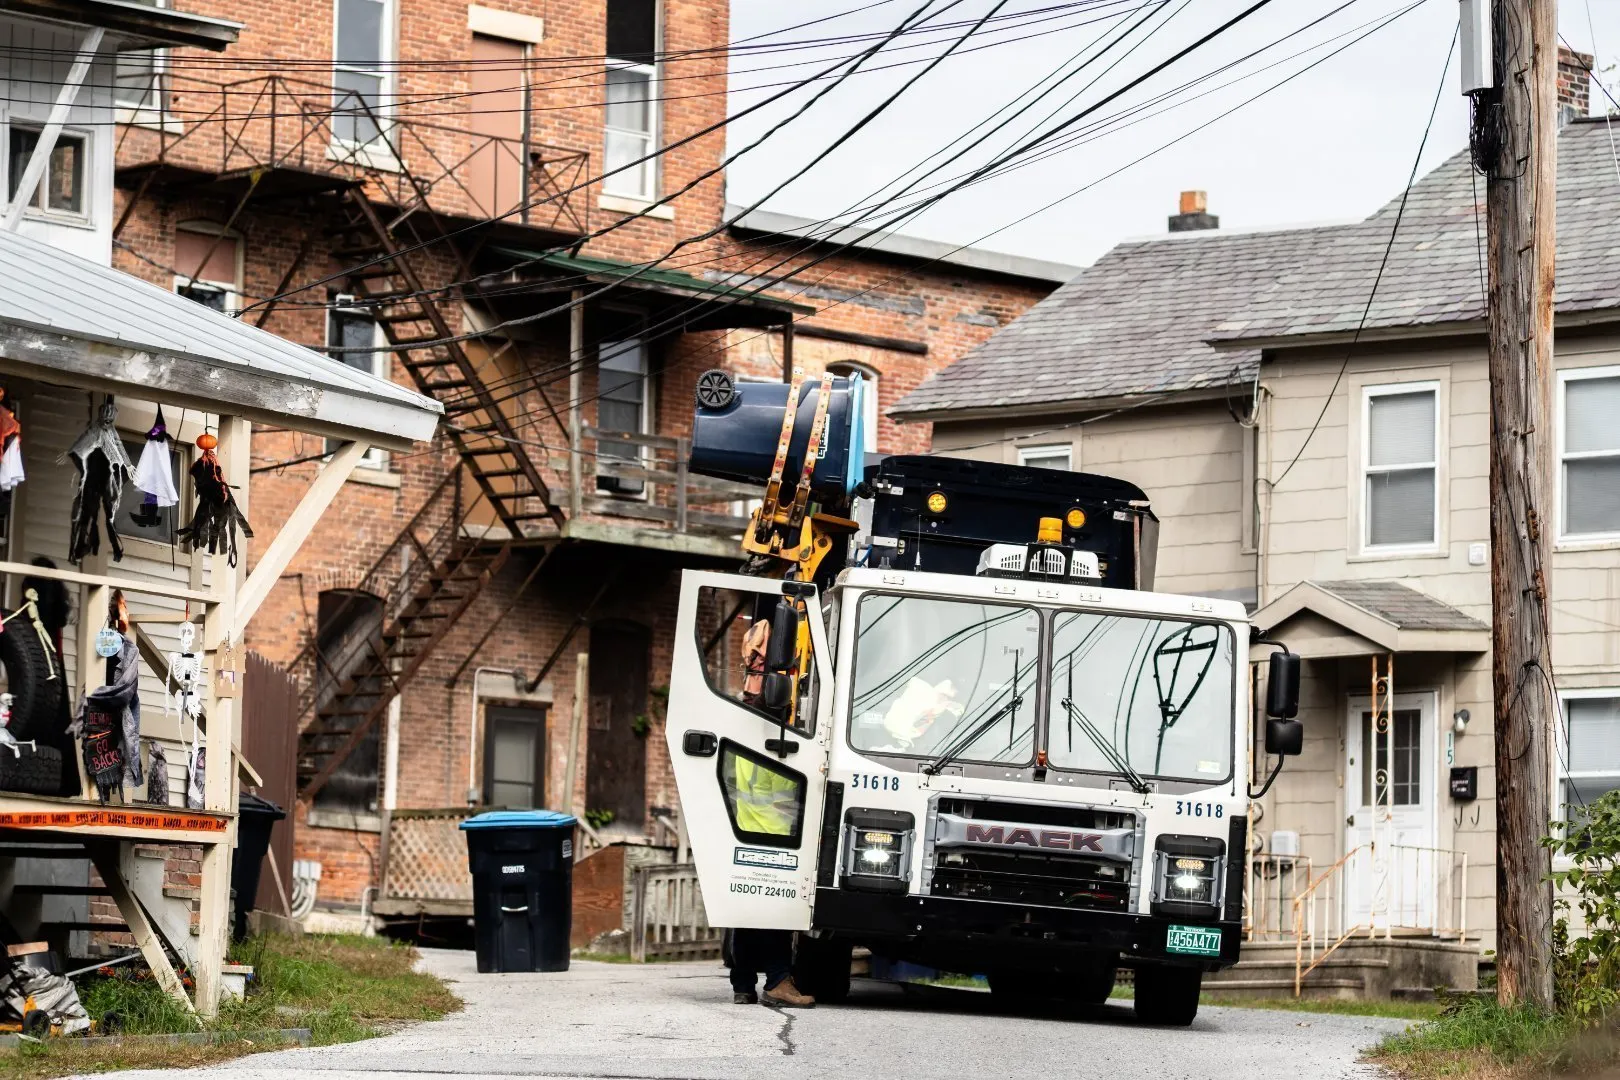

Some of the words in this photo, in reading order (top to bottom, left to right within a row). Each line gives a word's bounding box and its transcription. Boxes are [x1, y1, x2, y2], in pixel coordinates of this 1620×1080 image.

[96, 739, 108, 755] GO
[1447, 733, 1453, 765] 15
[92, 751, 121, 771] BACK!
[852, 773, 900, 792] 31618
[1175, 801, 1223, 818] 31618
[966, 823, 1104, 853] MACK
[730, 883, 763, 895] USDOT
[764, 886, 797, 899] 224100
[1174, 932, 1218, 949] 456A477
